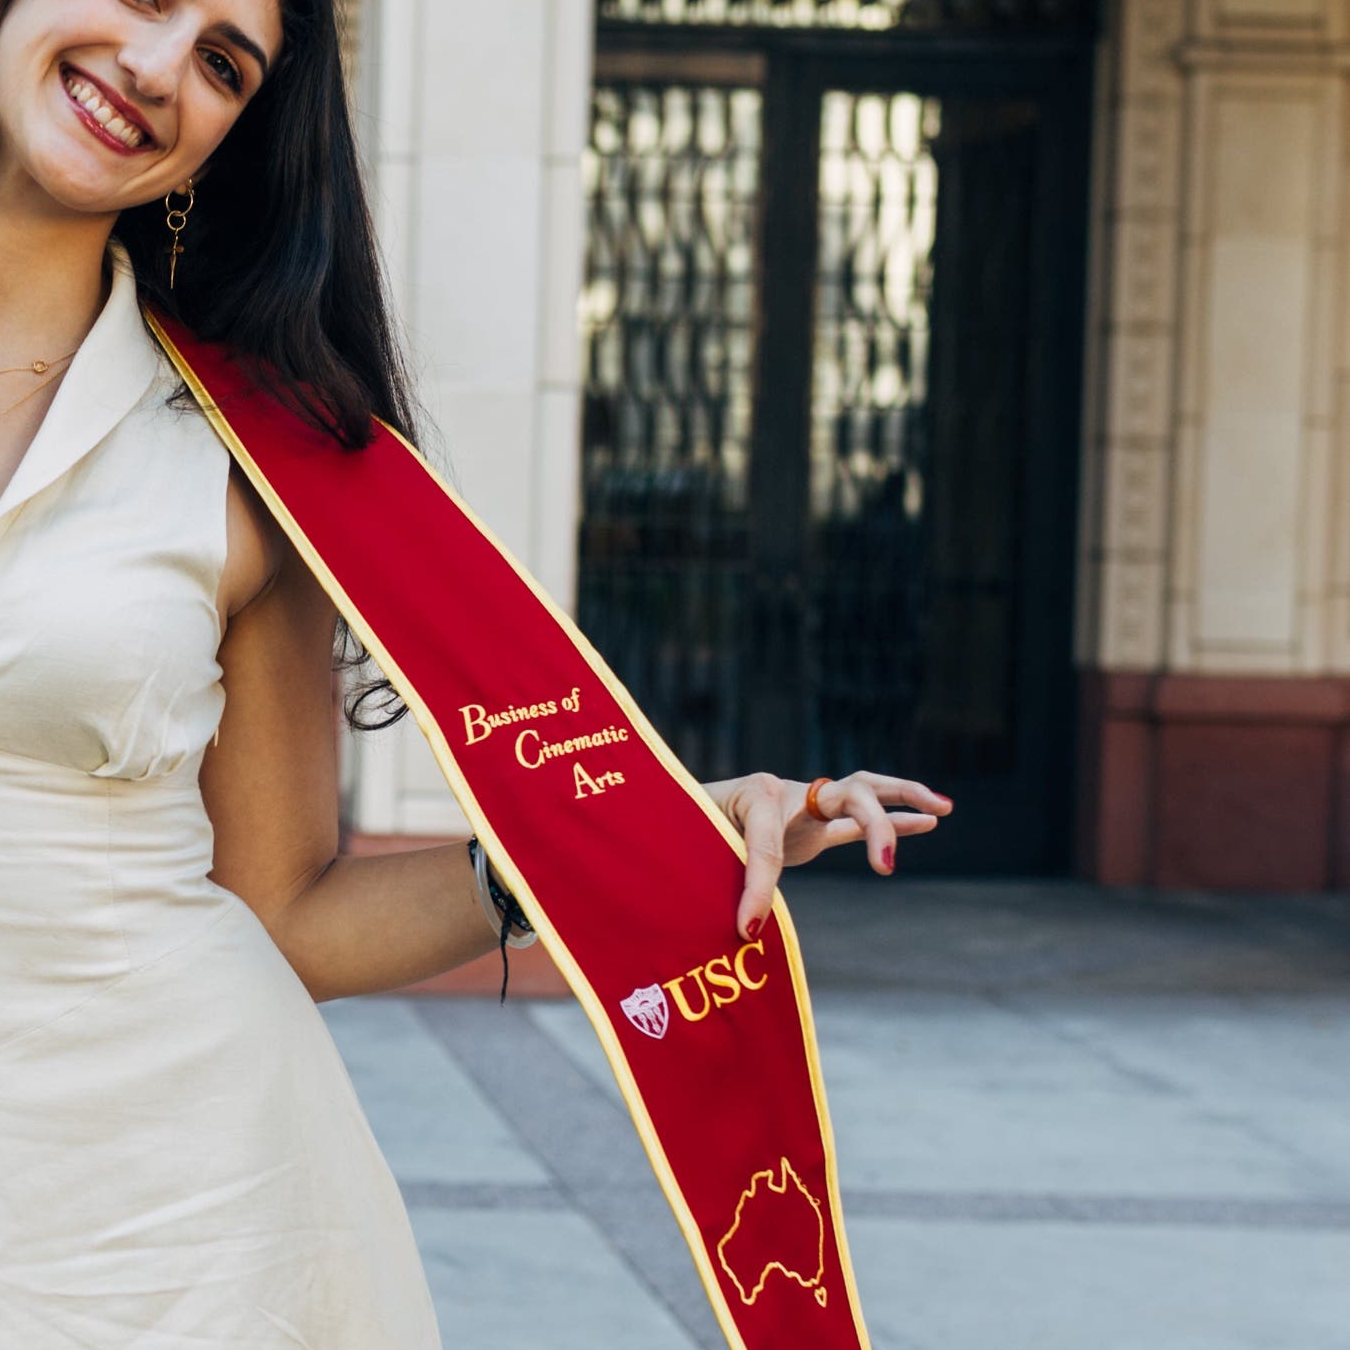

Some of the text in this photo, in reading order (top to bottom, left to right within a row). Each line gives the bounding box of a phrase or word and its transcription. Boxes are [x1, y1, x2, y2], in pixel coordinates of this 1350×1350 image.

[458, 687, 581, 746] Business of
[515, 725, 629, 769] Cinematic
[573, 762, 626, 800] Arts
[662, 938, 768, 1022] USC
